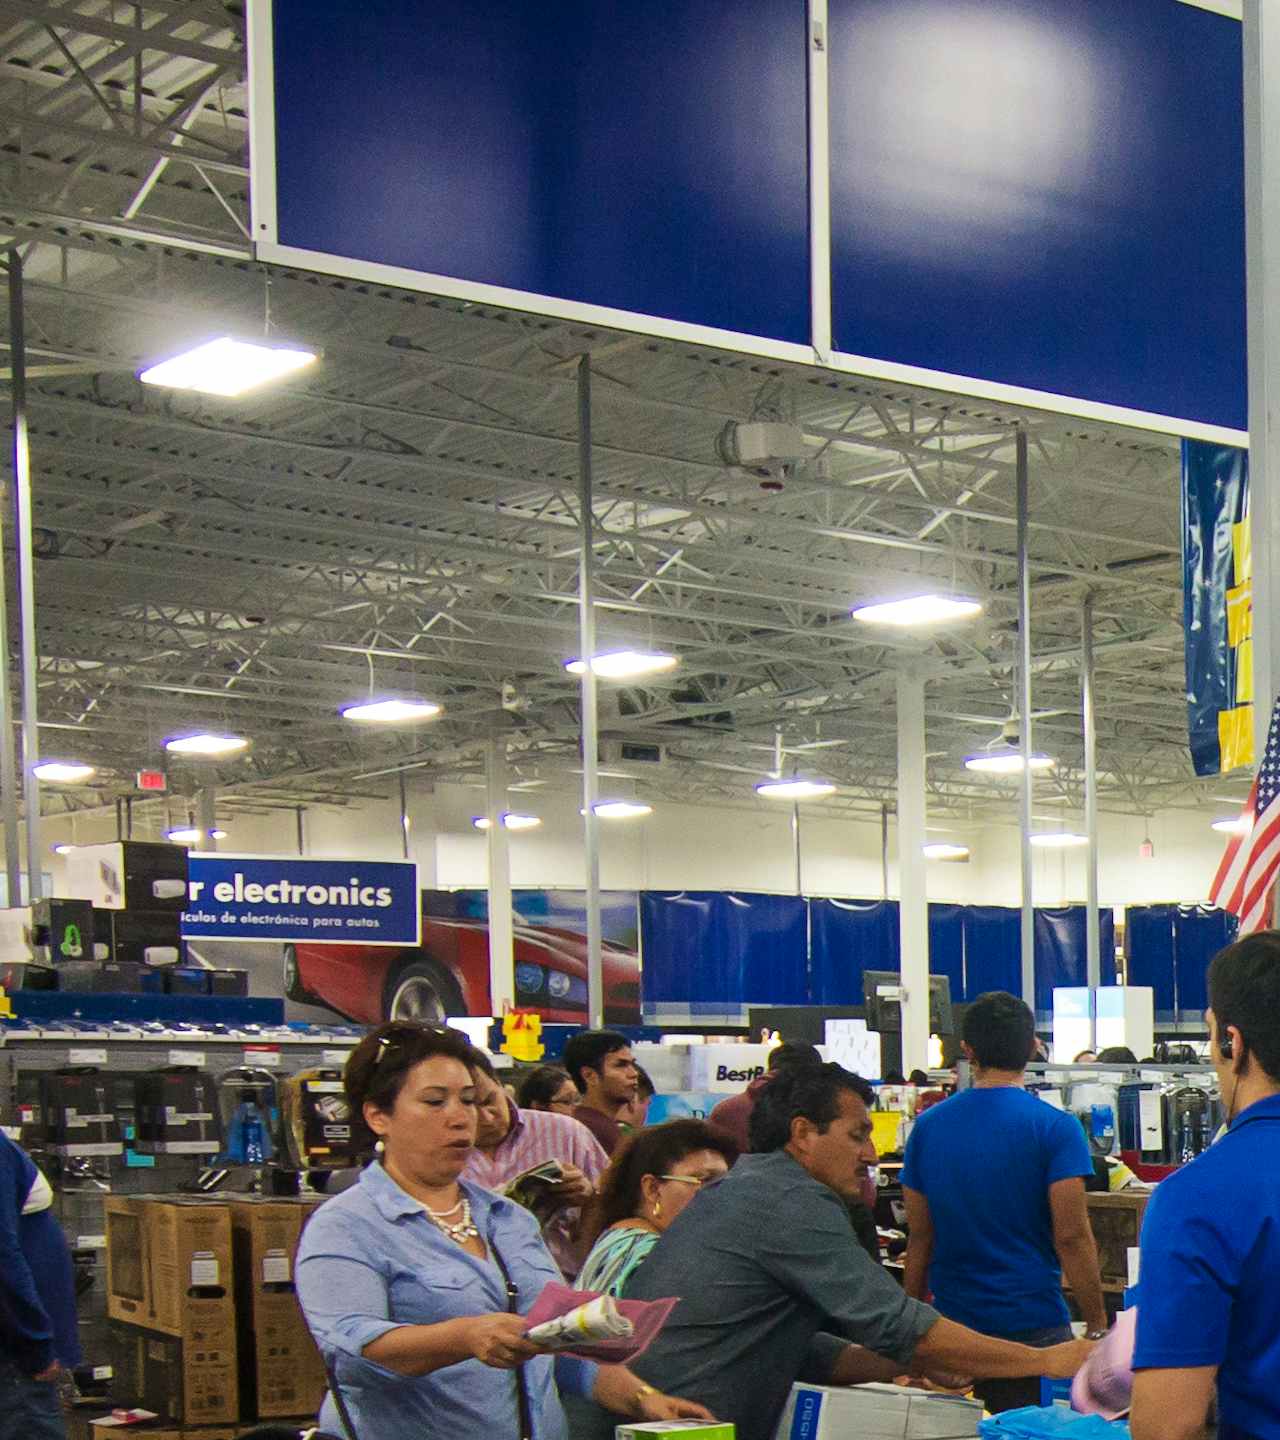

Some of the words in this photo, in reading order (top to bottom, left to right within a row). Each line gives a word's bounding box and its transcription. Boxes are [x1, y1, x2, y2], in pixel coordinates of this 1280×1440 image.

[214, 873, 393, 907] electronics
[221, 912, 237, 924] de
[240, 912, 308, 926] electrónica
[313, 916, 342, 928] para
[346, 917, 380, 928] autos
